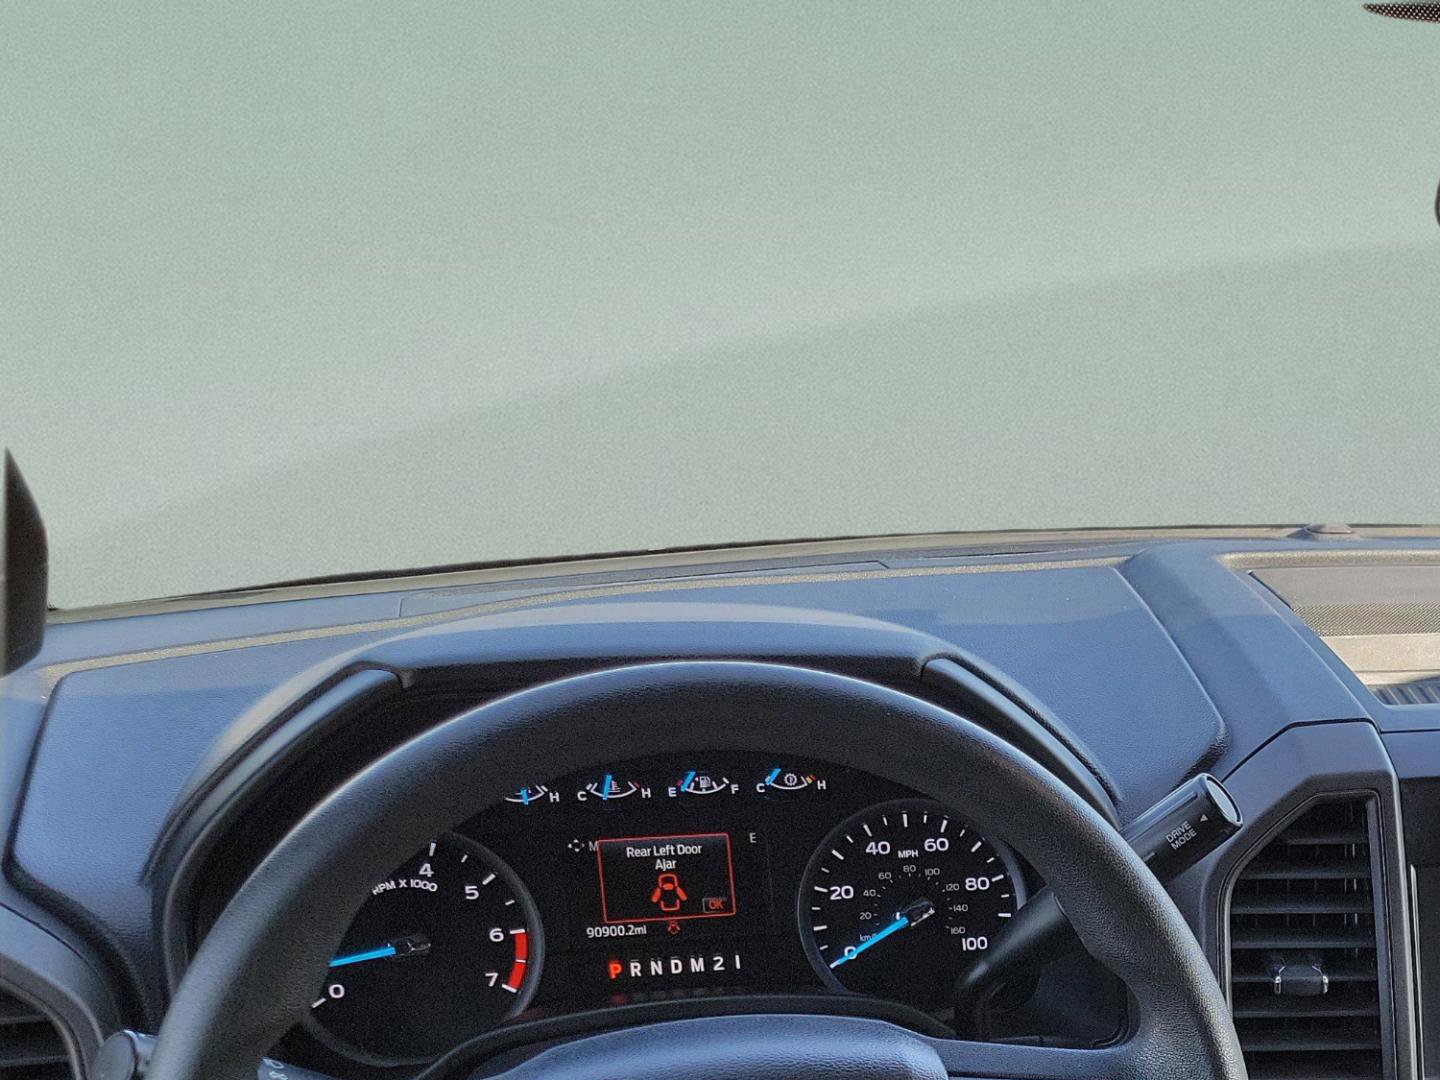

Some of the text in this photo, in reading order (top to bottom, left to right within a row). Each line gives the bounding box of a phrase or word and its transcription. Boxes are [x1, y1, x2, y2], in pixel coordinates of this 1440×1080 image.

[668, 787, 677, 797] E
[731, 785, 739, 795] F
[817, 780, 827, 790] H
[1165, 820, 1193, 842] DRIVE
[924, 837, 949, 852] 60
[1170, 829, 1197, 851] MODE
[626, 844, 703, 858] Rear Left Door
[866, 841, 891, 855] 40
[898, 849, 919, 859] MPH
[419, 863, 434, 878] 4
[655, 858, 677, 871] Ajar
[410, 879, 438, 892] 1000
[965, 877, 990, 892] 80
[465, 886, 480, 900] 5
[829, 885, 854, 900] 20
[708, 900, 724, 910] OK
[489, 928, 504, 942] 6
[961, 937, 988, 951] 100
[630, 962, 642, 977] R
[650, 960, 663, 976] N
[671, 959, 683, 974] D
[690, 957, 704, 973] M
[713, 956, 725, 971] 2
[486, 972, 499, 987] 7
[328, 984, 345, 998] 0
